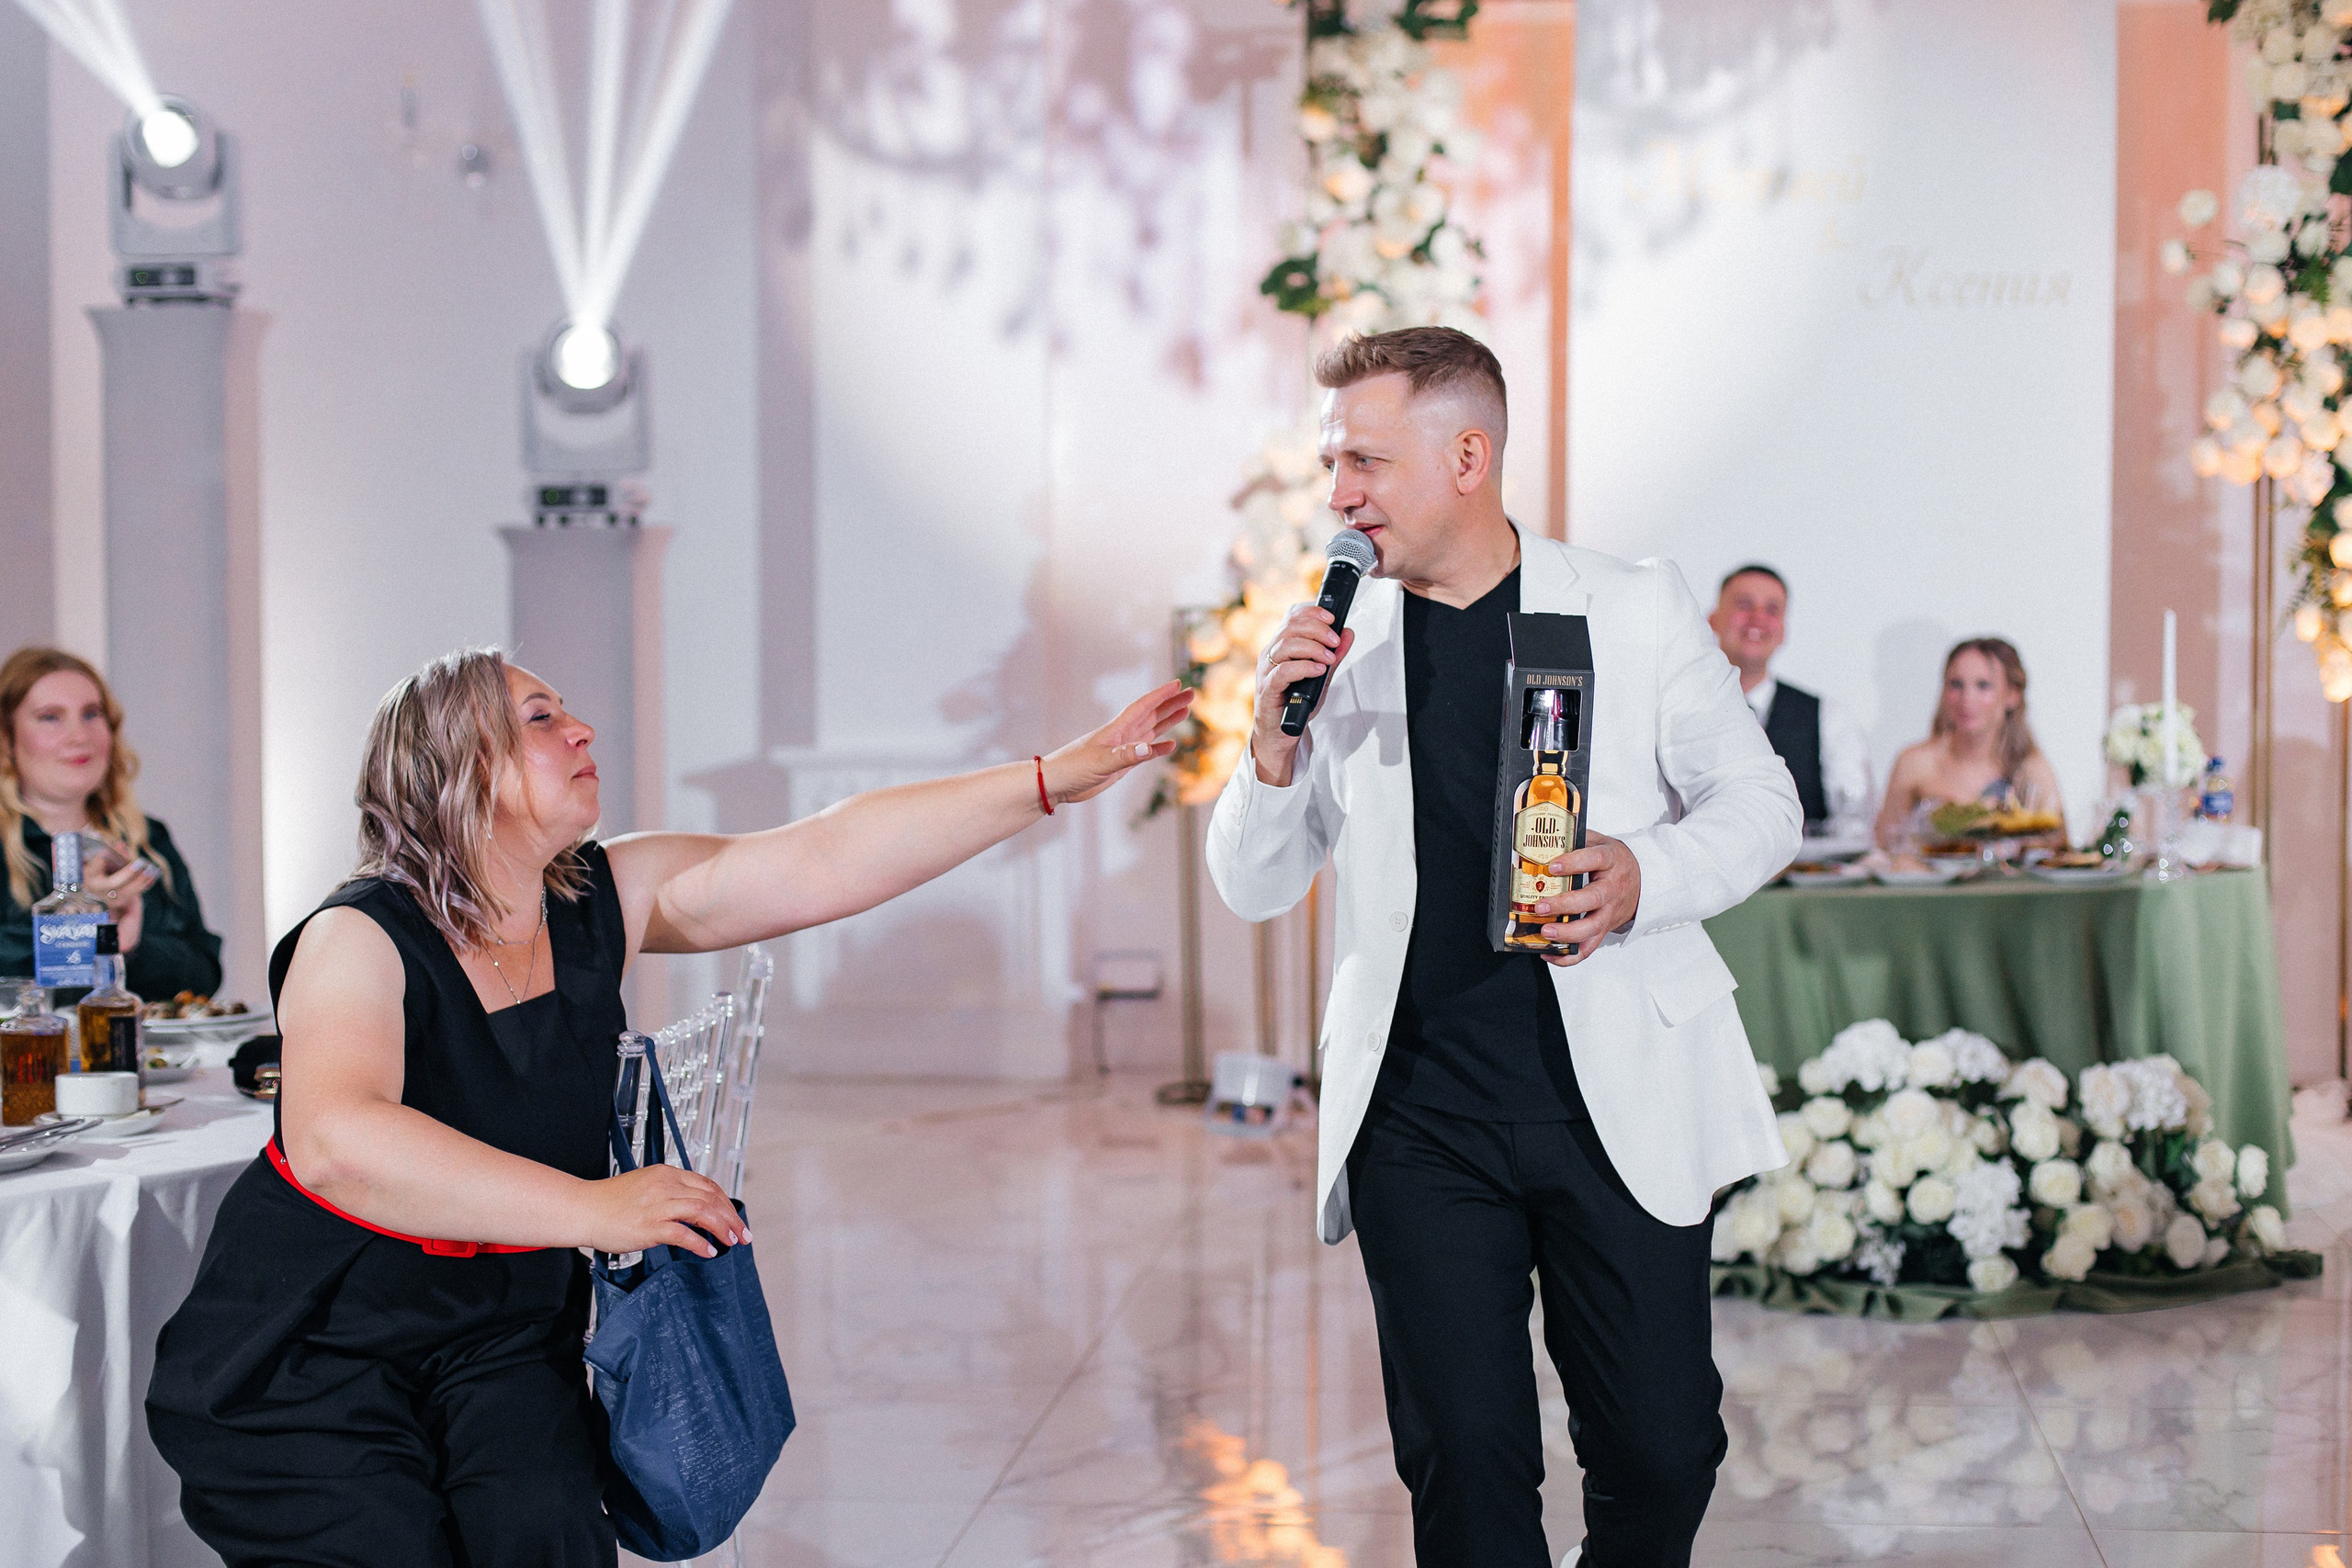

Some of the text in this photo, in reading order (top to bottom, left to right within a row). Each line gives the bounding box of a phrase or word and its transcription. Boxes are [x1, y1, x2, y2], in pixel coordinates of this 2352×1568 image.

[1858, 244, 2073, 308] Ксения
[1526, 673, 1583, 687] OLD JOHNSON'S
[1534, 817, 1556, 834] OLD
[1522, 835, 1566, 849] JOHNSON'S
